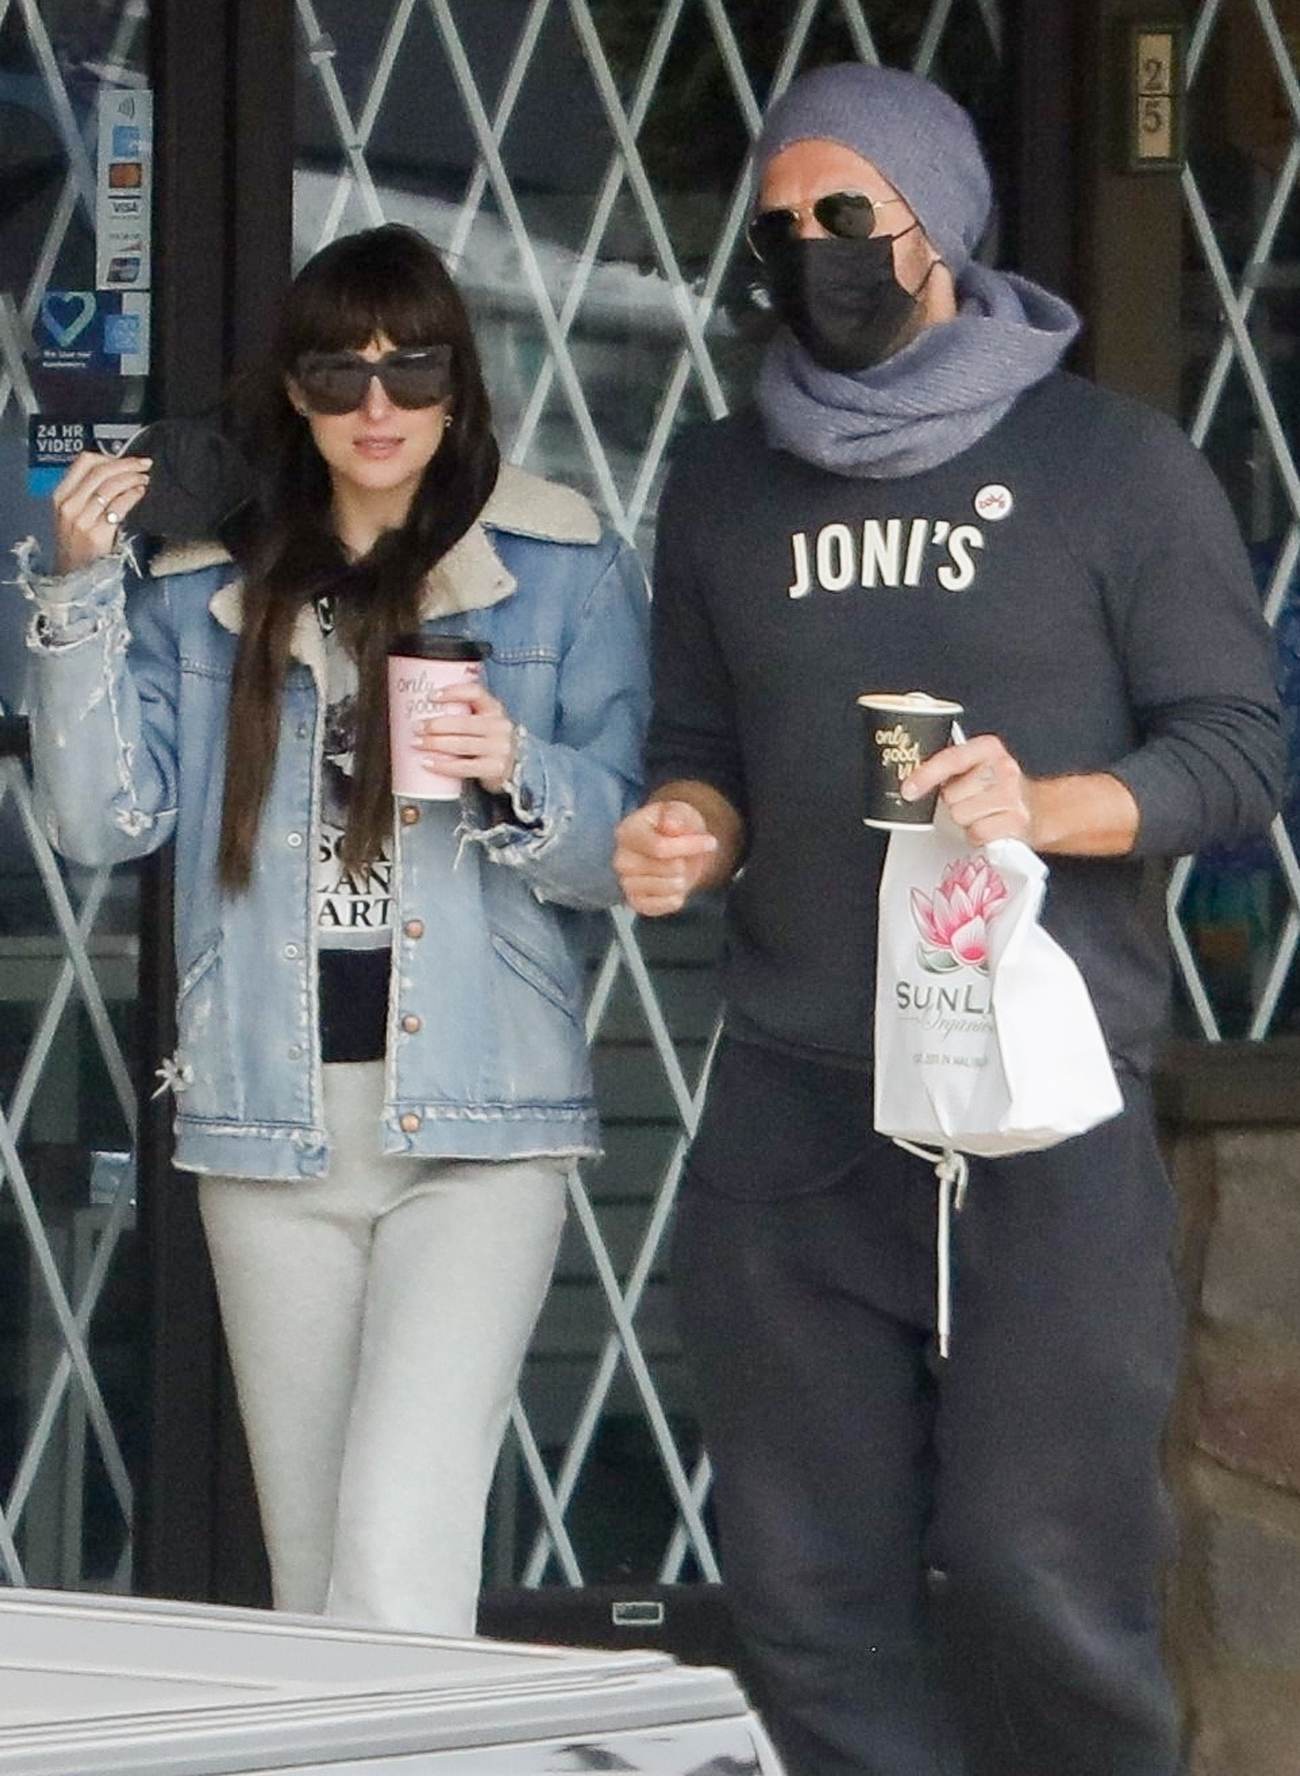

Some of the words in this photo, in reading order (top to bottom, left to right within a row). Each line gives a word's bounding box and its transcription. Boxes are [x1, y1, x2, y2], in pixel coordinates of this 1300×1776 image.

[112, 201, 138, 212] VISA
[37, 424, 57, 438] 24
[62, 424, 84, 438] HR
[36, 438, 84, 452] VIDEO
[788, 518, 983, 600] JONI'S
[397, 670, 436, 702] only
[875, 724, 910, 748] only
